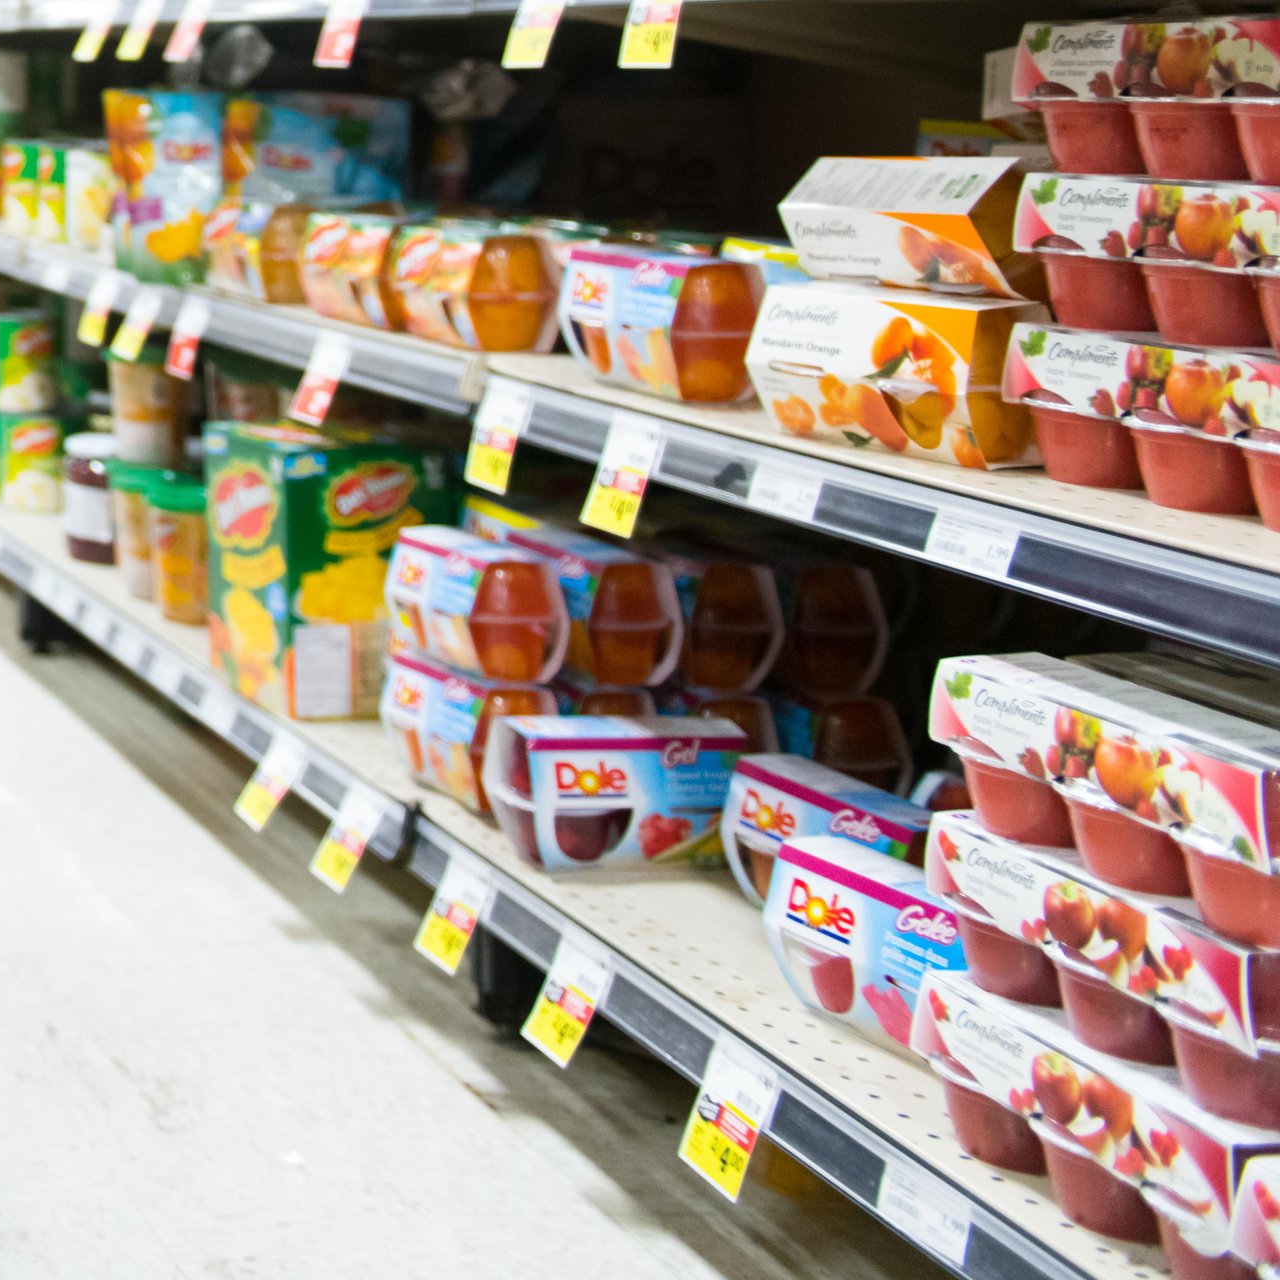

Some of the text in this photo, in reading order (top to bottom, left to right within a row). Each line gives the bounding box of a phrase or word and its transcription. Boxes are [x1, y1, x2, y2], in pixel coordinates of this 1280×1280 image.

[1052, 30, 1116, 56] Compliments
[1059, 187, 1130, 210] Compliments
[573, 272, 608, 303] Dole
[767, 304, 839, 326] Compliments
[761, 336, 842, 357] Mandarin Orange
[1047, 342, 1120, 367] Compliments
[975, 688, 1046, 726] Compliments
[554, 759, 628, 797] Dole
[741, 787, 796, 837] Dole
[967, 848, 1037, 891] Compliments
[787, 876, 855, 935] Dole
[896, 904, 957, 945] Gelée
[955, 1010, 1025, 1059] Compliments
